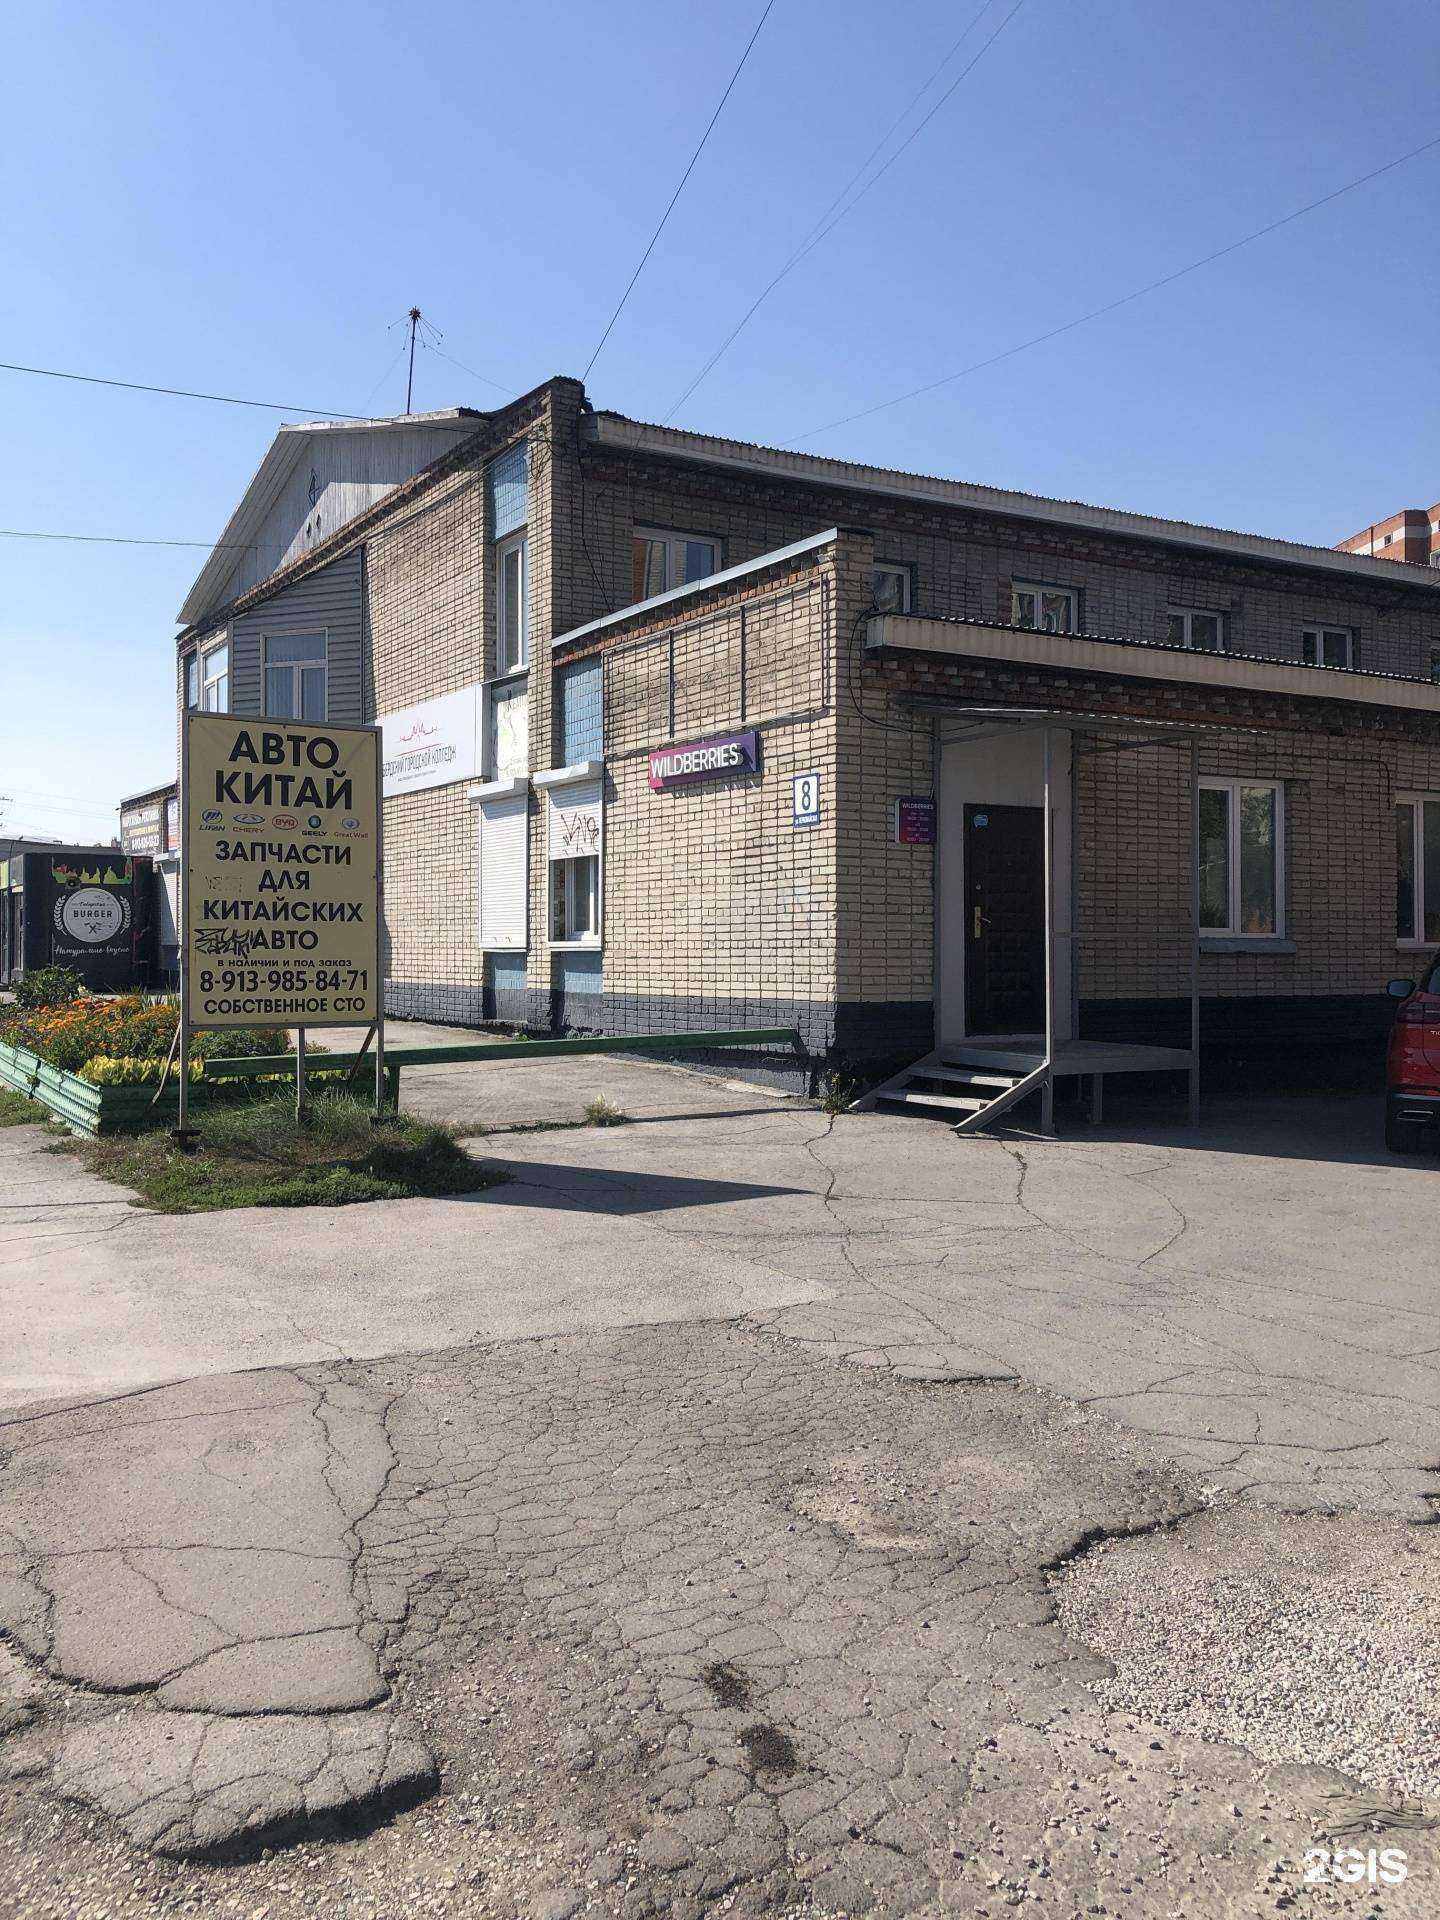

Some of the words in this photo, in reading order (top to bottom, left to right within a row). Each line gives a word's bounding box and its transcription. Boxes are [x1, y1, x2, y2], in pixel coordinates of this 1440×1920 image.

[228, 731, 339, 769] АВТО
[650, 743, 740, 778] WILDBERRIES
[215, 770, 352, 810] КИТАЙ
[802, 780, 811, 811] 8
[902, 802, 934, 810] WILDBERRIES
[215, 840, 352, 866] ЗАПЧАСТИ
[258, 869, 311, 893] ДЛЯ
[73, 910, 113, 918] BURGER
[203, 895, 364, 922] КИТАЙСКИХ
[251, 927, 319, 950] АВТО
[293, 959, 315, 968] под
[318, 959, 352, 967] заказ
[199, 969, 368, 993] 8-913-985-84-71
[203, 997, 328, 1015] СОБСТВЕННОЕ
[333, 997, 366, 1012] СТО
